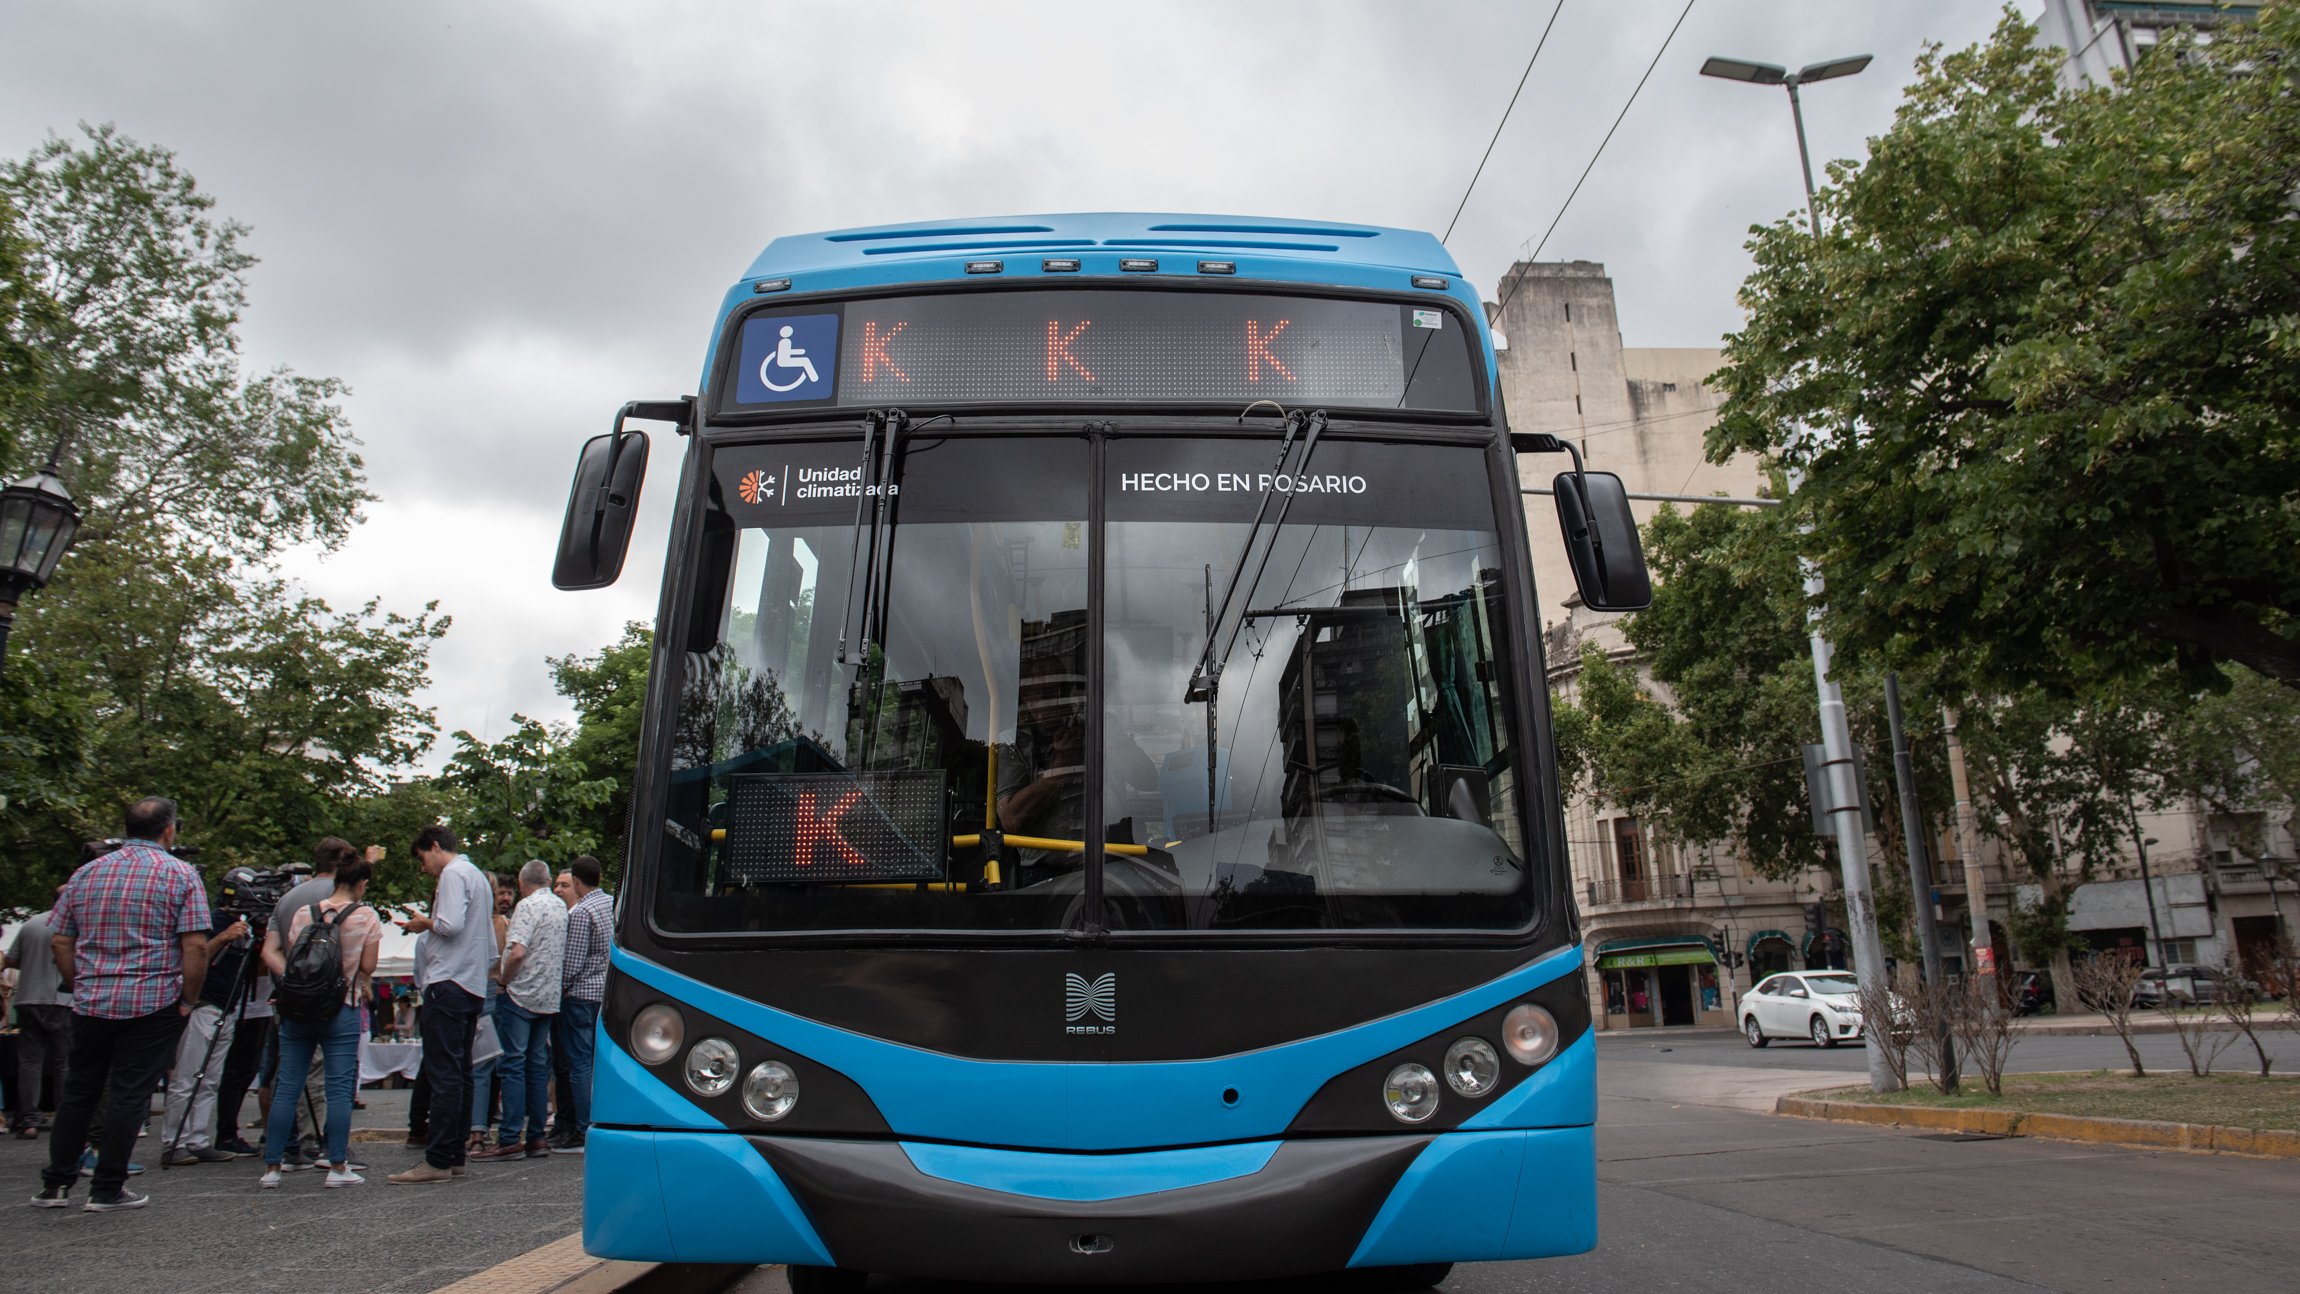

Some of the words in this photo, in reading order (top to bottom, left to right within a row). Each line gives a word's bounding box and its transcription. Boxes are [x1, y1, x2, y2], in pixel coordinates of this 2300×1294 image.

[862, 321, 911, 383] K
[1047, 320, 1096, 382] K
[1247, 320, 1297, 381] K
[798, 466, 862, 483] Unidad
[1121, 472, 1210, 491] HECHO
[1217, 473, 1250, 492] EN
[1258, 473, 1367, 494] ROSARIO
[795, 791, 865, 865] K
[1066, 1025, 1116, 1035] REBUS
